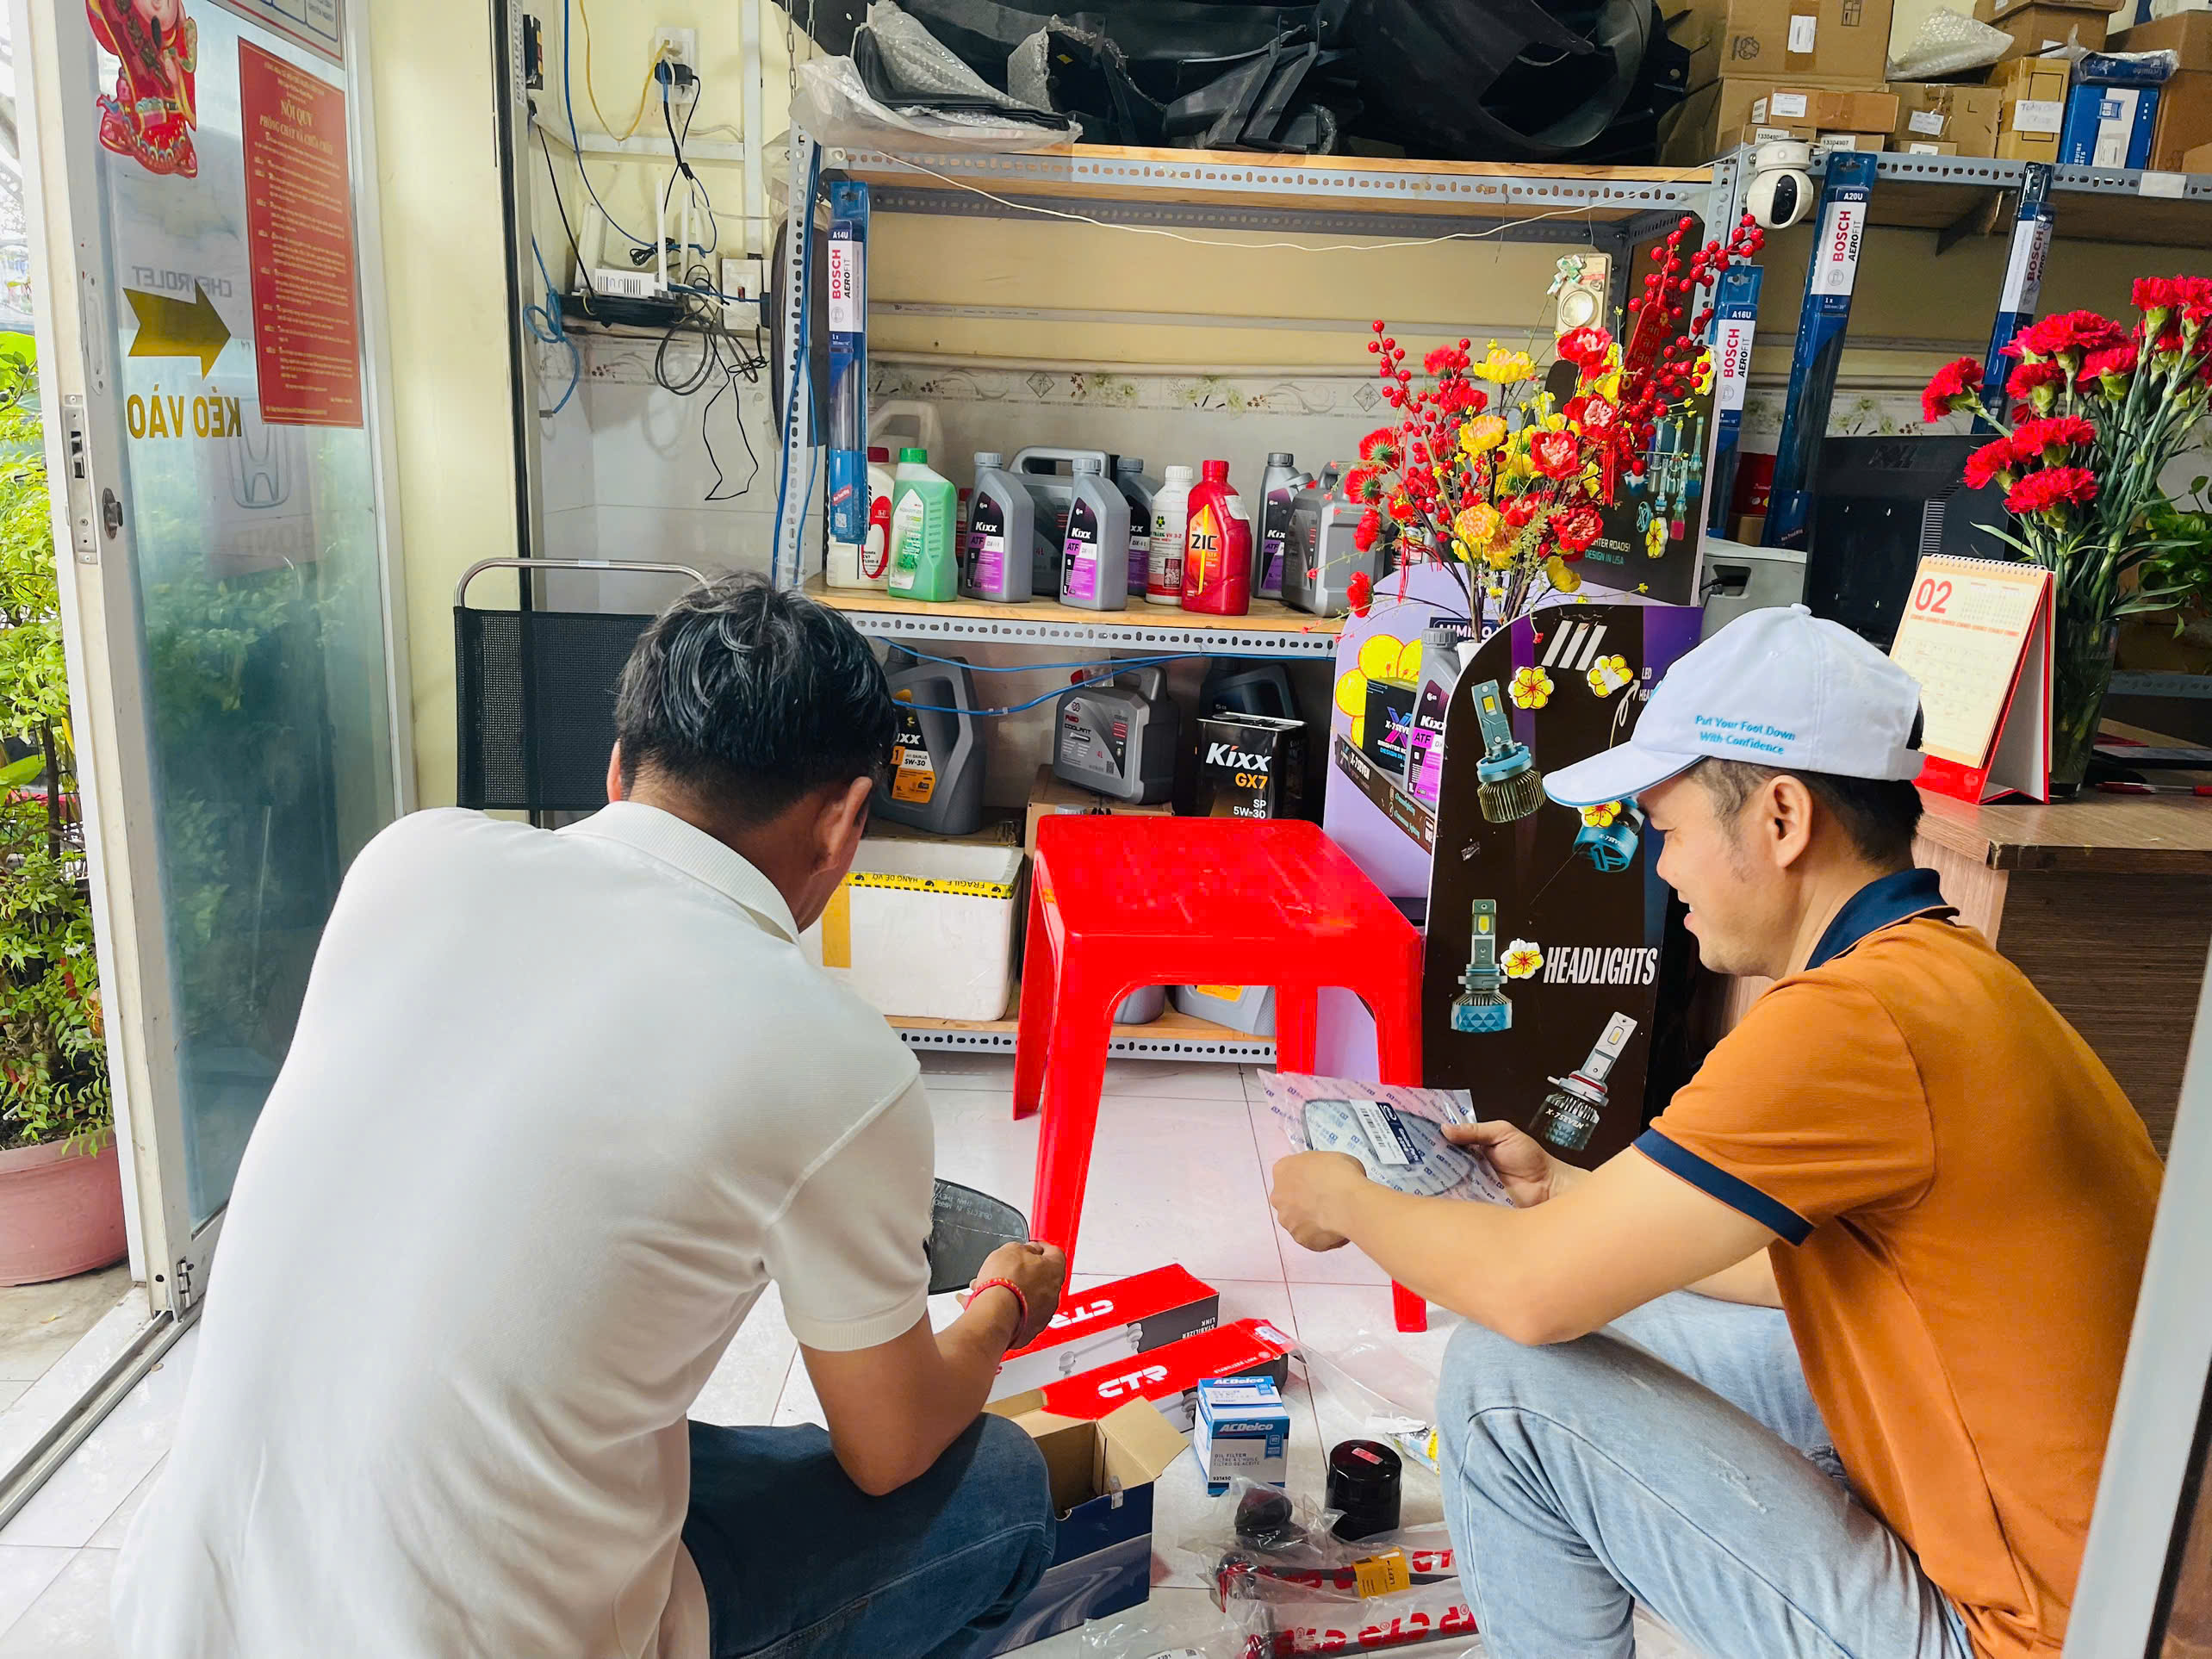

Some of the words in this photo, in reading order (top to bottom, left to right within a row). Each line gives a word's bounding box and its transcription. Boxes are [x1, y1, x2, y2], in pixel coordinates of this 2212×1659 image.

[1843, 192, 1863, 201] A20U
[832, 231, 849, 239] A14U
[1832, 210, 1852, 262] BOSCH
[1849, 221, 1861, 262] AEROFIT
[2027, 230, 2045, 282] BOSCH
[831, 249, 842, 300] BOSCH
[1731, 310, 1752, 319] A16U
[1724, 328, 1740, 378] BOSCH
[1737, 337, 1750, 378] AEROFIT
[975, 521, 997, 532] Kixx
[1071, 527, 1091, 539] Kixx
[1267, 529, 1286, 539] Kix
[970, 537, 985, 545] ATF
[1067, 542, 1079, 552] ATF
[1190, 534, 1217, 550] ZIC
[1608, 539, 1631, 552] ROADS!
[1585, 550, 1605, 562] DESIGN
[1605, 553, 1612, 562] IN
[1612, 555, 1625, 565] USA
[1915, 578, 1953, 614] 02
[1641, 667, 1652, 680] LED
[1639, 689, 1653, 702] HEA
[1064, 723, 1092, 735] COOLANT
[1385, 720, 1410, 735] X-7SEVE
[1695, 714, 1712, 726] Put
[1715, 717, 1737, 730] Your
[1741, 721, 1763, 733] Foot
[1767, 725, 1796, 741] Down
[1414, 732, 1432, 744] ATF
[1699, 731, 1723, 743] With
[1725, 736, 1785, 755] Confidence
[1096, 750, 1103, 759] 4L
[1205, 742, 1272, 773] Kixx
[904, 758, 926, 767] 5W-30
[1234, 772, 1269, 790] GX7
[1252, 798, 1267, 809] SP
[1233, 806, 1266, 819] 5W-30
[947, 879, 985, 890] FRAGILE
[1543, 947, 1658, 985] HEADLIGHTS
[934, 1198, 952, 1210] MIRRO
[966, 1208, 993, 1221] OBJECTS
[1048, 1299, 1114, 1329] CTR
[1201, 1316, 1215, 1327] LINK
[1182, 1324, 1215, 1339] STABILIZER
[1097, 1364, 1168, 1398] CTR
[1219, 1423, 1274, 1432] ACDelco
[1386, 1567, 1395, 1585] LEFT
